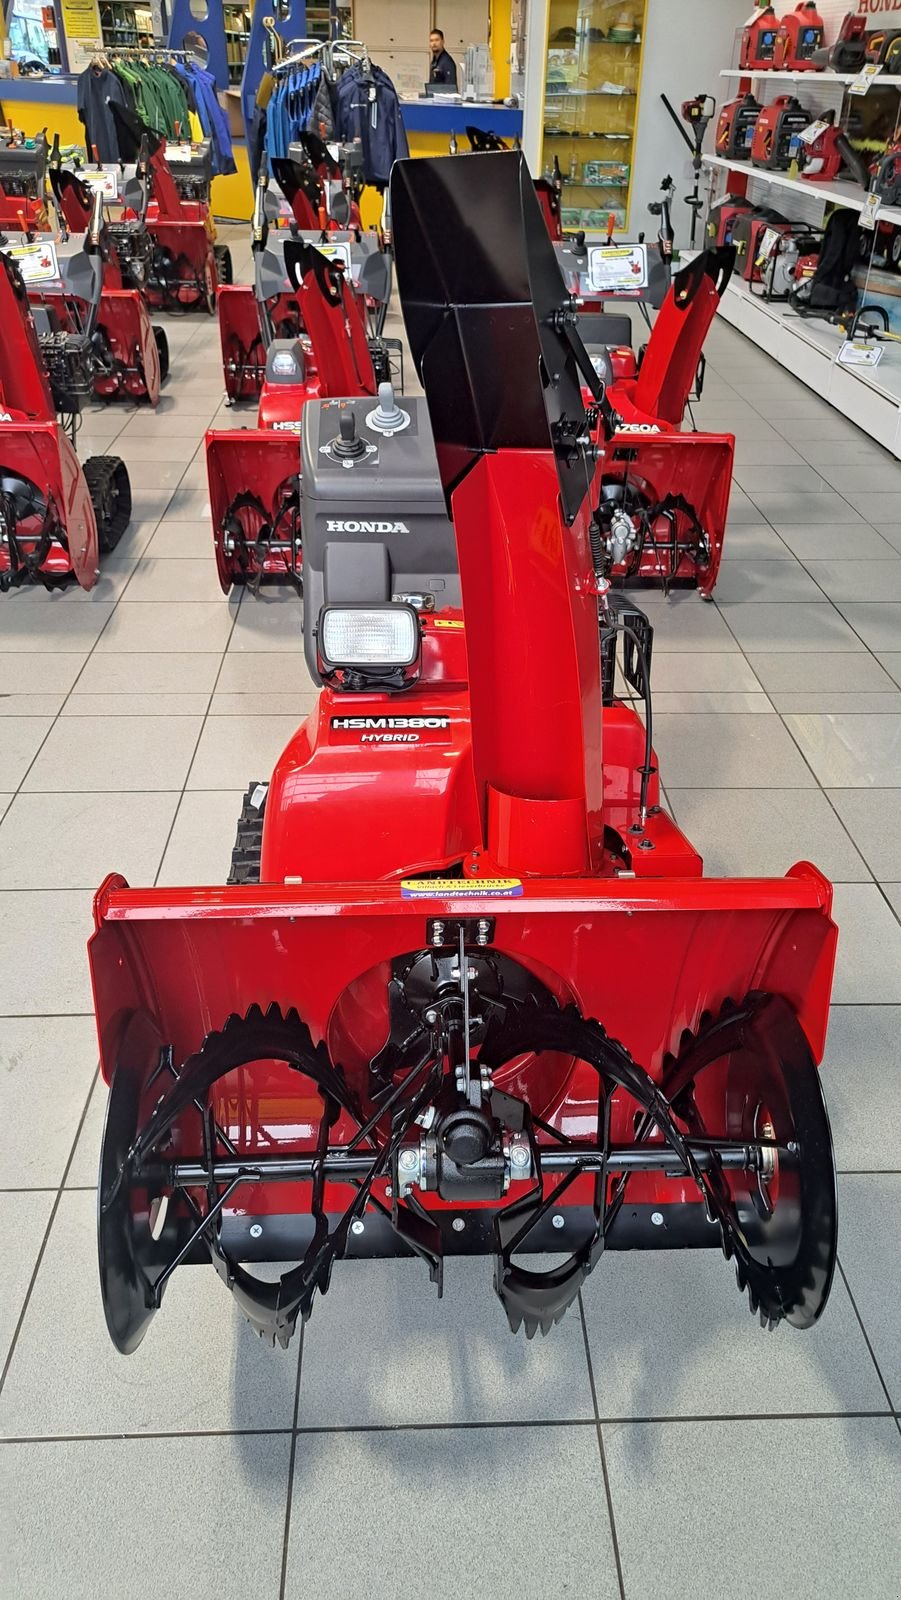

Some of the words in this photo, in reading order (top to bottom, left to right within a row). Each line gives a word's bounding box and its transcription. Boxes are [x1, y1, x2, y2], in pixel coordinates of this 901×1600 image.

[326, 520, 410, 534] HONDA
[361, 733, 420, 742] HYBRID
[409, 890, 513, 898] www.landtechnik.co.at
